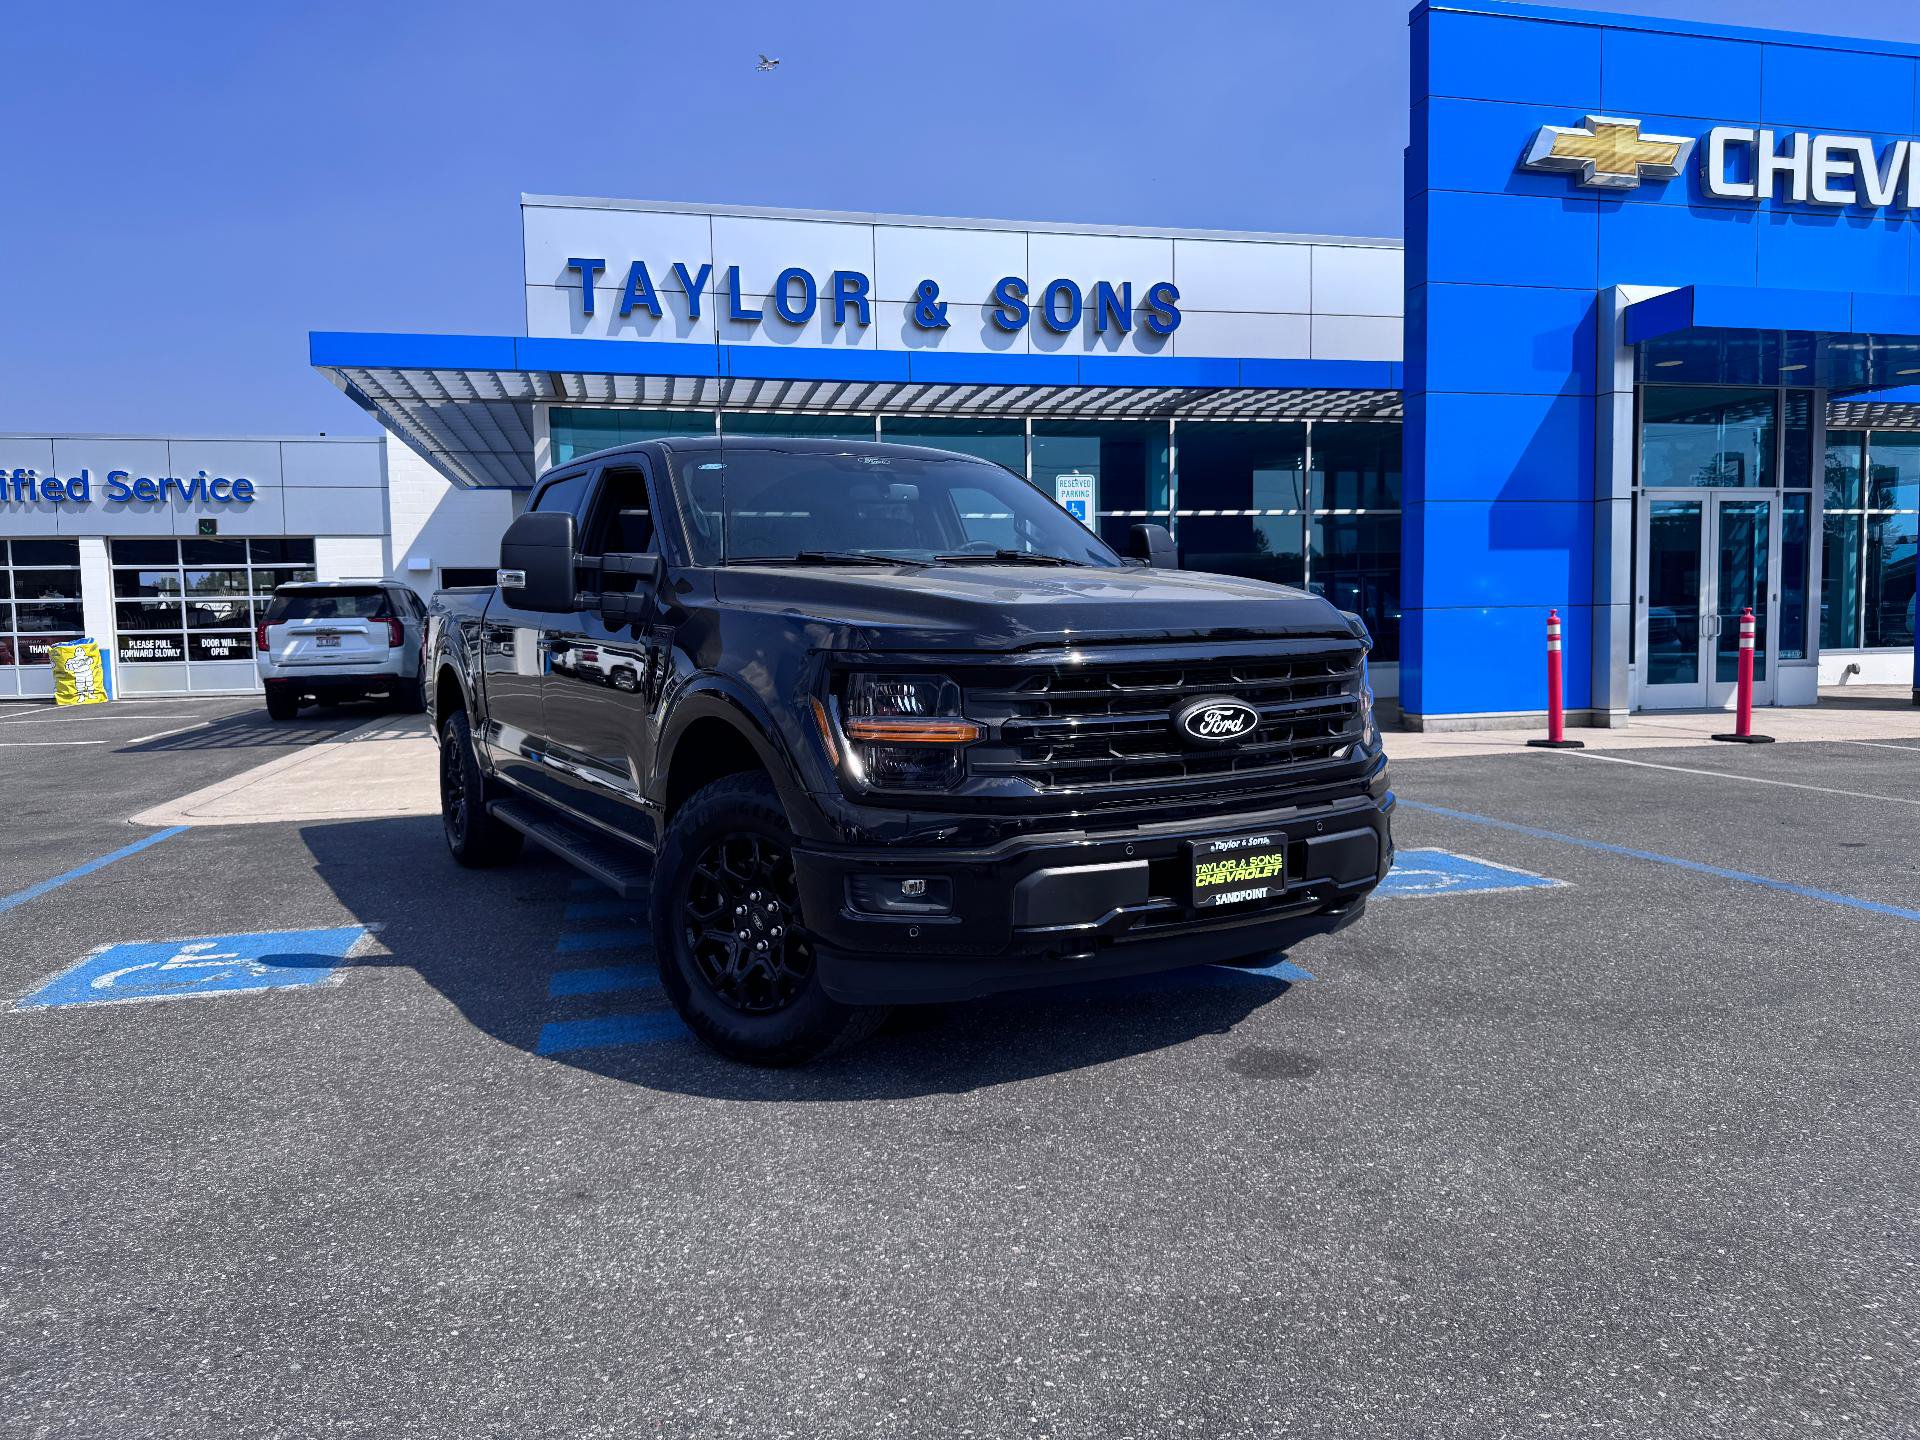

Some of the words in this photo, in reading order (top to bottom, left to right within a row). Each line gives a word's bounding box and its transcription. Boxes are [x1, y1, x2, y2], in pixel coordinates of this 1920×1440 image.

[1706, 126, 1920, 209] CHEV
[567, 257, 871, 326] TAYLOR
[914, 279, 951, 328] &
[992, 276, 1182, 335] SONS
[0, 469, 90, 502] ified
[106, 470, 254, 502] Service
[1059, 479, 1091, 488] RESERVED
[1061, 490, 1090, 498] PARKING
[129, 640, 154, 649] PLEASE
[155, 639, 172, 649] PULL
[201, 638, 220, 648] DOOR
[221, 638, 238, 647] WILL
[29, 645, 51, 654] THAN
[120, 648, 154, 658] FORWARD
[154, 648, 181, 658] SLOWLY
[211, 647, 229, 656] OPEN
[1199, 709, 1245, 735] Ford
[1214, 840, 1240, 851] Taylor
[1195, 859, 1237, 874] TAYLOR
[1239, 858, 1246, 868] &
[1249, 854, 1282, 865] SONS
[1195, 865, 1282, 887] CHEVROLET
[1215, 887, 1267, 905] SANDPOINT
